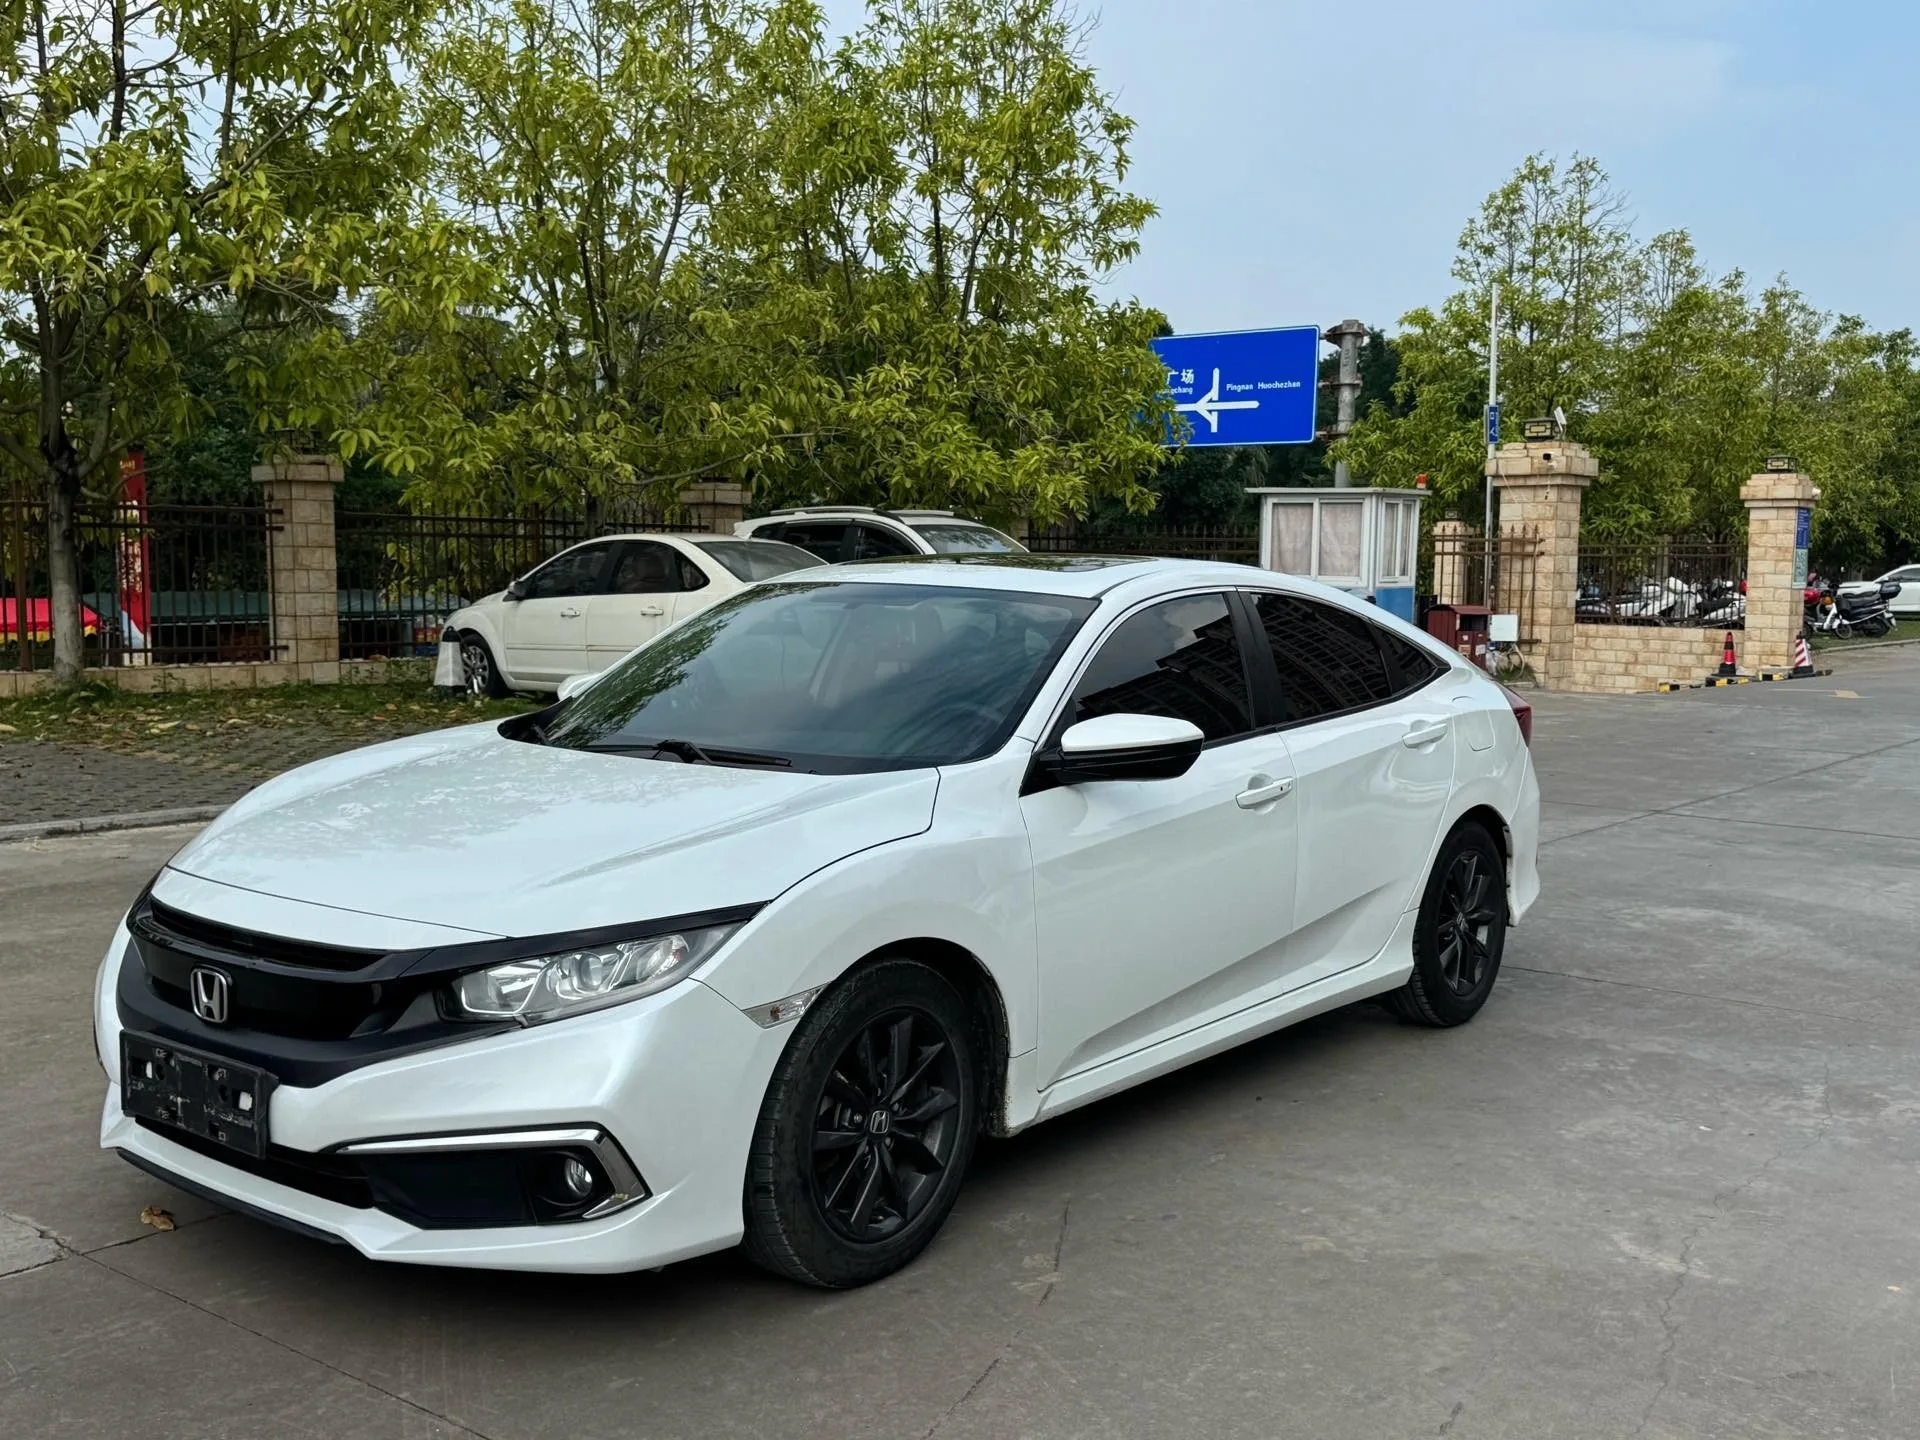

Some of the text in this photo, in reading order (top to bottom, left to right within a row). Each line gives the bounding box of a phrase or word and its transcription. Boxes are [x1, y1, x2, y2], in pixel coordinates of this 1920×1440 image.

[1167, 368, 1194, 384] 广场
[1226, 380, 1301, 393] Pingnan Huochezhan
